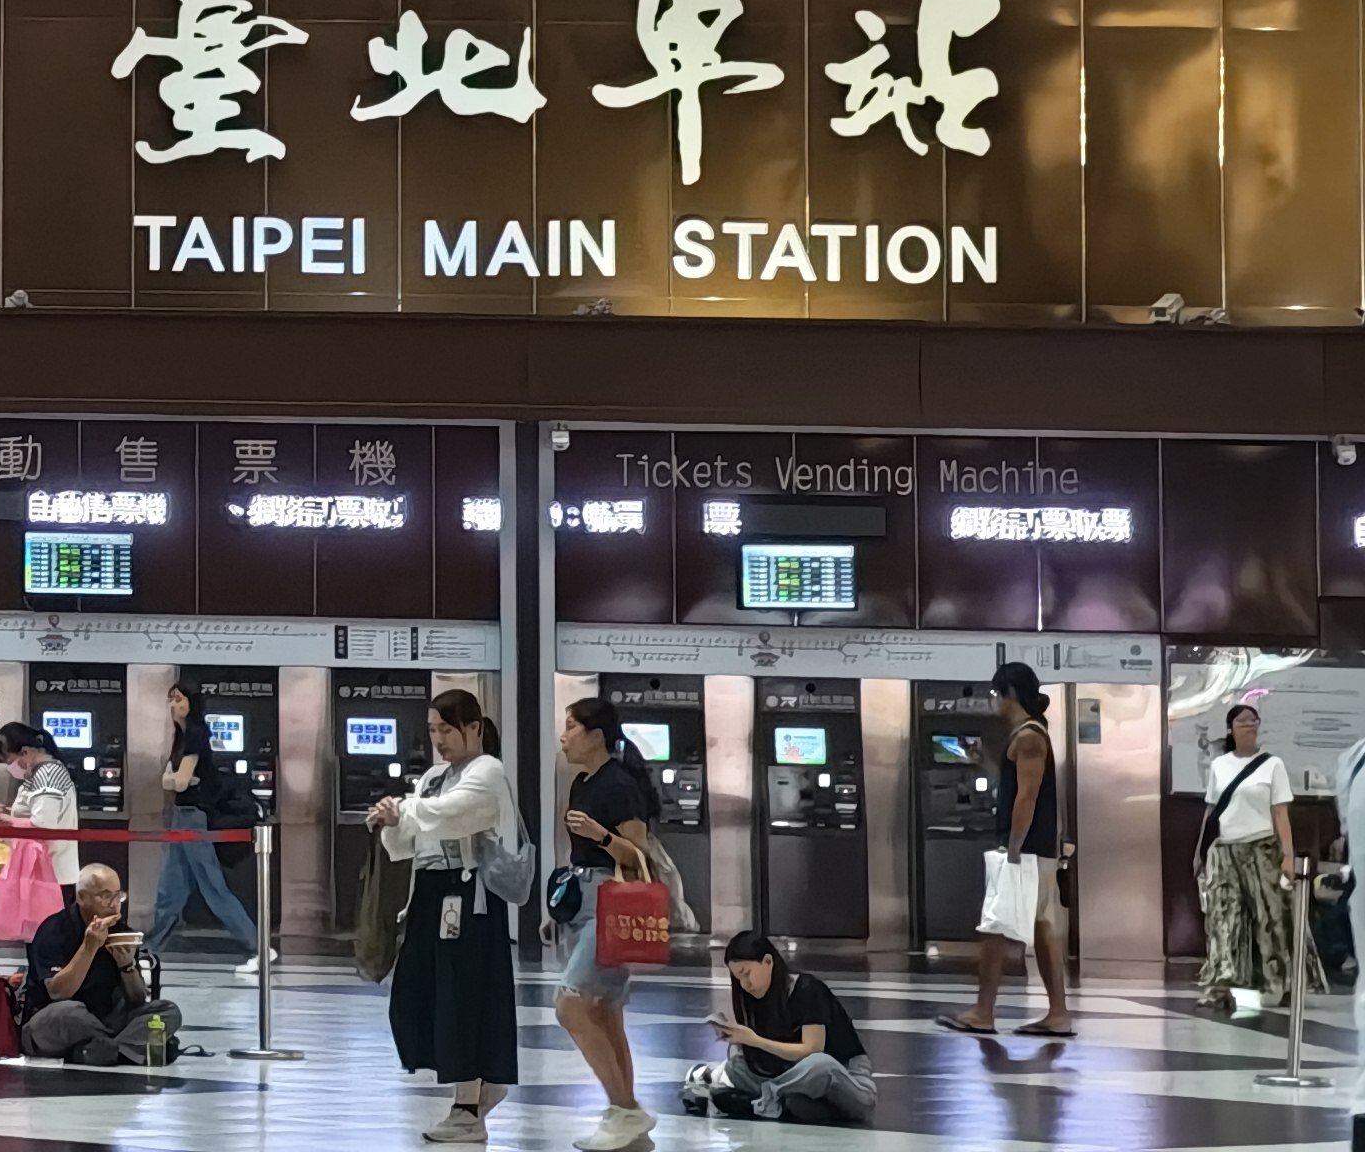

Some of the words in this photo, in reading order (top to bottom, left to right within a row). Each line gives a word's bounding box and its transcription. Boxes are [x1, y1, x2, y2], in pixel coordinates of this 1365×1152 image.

[134, 216, 365, 274] TAIPEI
[425, 220, 615, 276] MAIN
[673, 217, 996, 283] STATION
[616, 452, 753, 491] Tickets
[775, 456, 914, 497] Vending
[938, 459, 1081, 496] Machine
